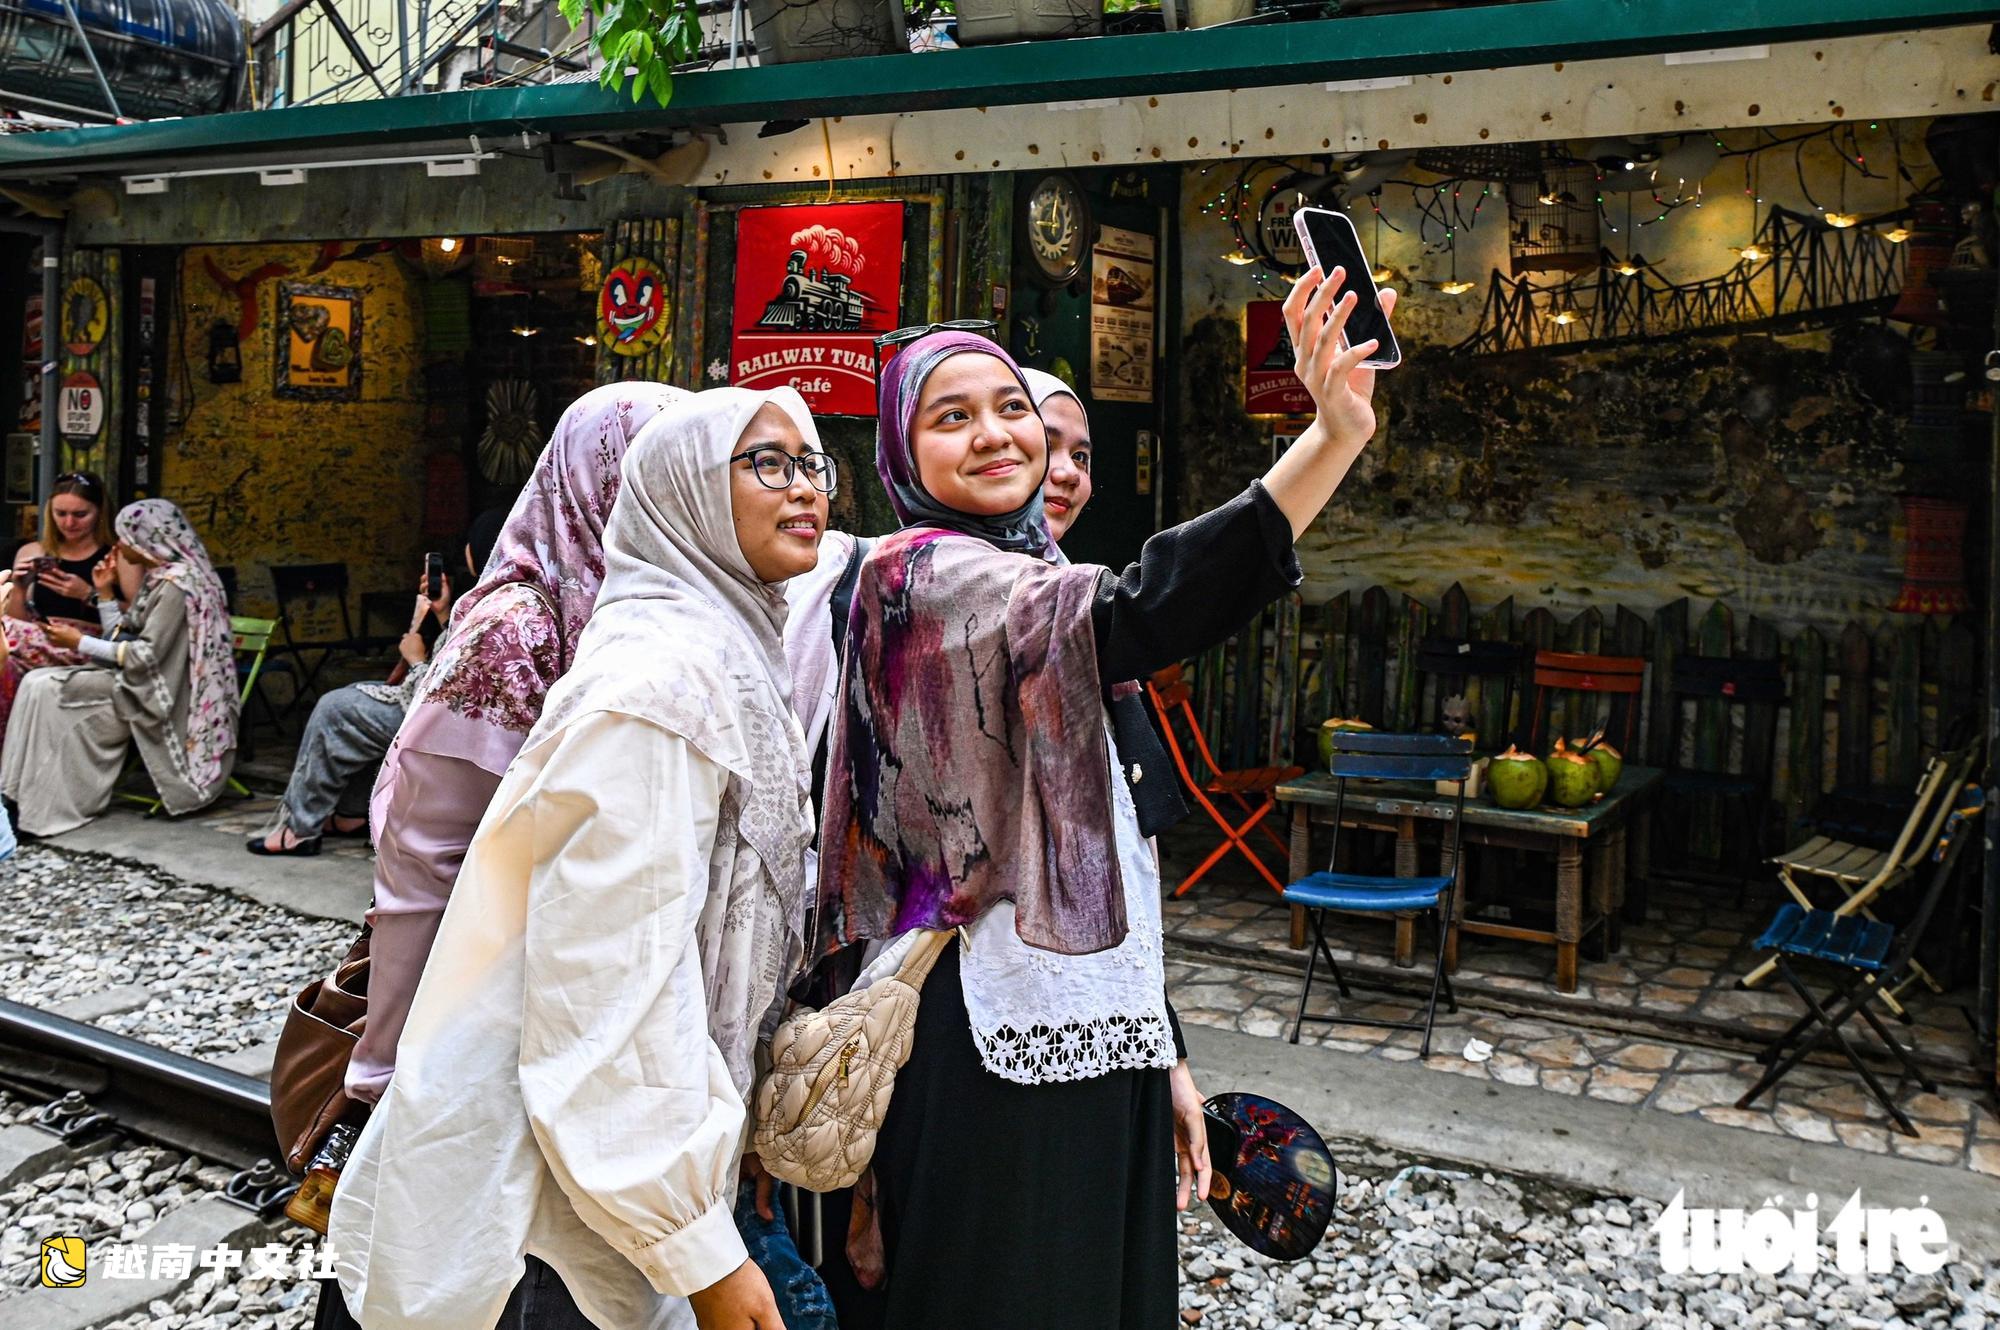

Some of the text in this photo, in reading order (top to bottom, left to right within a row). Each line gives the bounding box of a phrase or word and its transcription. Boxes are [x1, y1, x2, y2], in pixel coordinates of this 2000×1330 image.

[1271, 217, 1292, 227] FRE
[1272, 229, 1298, 248] Wi
[738, 348, 826, 377] RAILWAY
[789, 377, 832, 393] Café
[1250, 377, 1304, 395] RAILWA
[67, 389, 92, 410] NO
[67, 412, 91, 421] STUPID
[66, 422, 91, 432] PEOPLE
